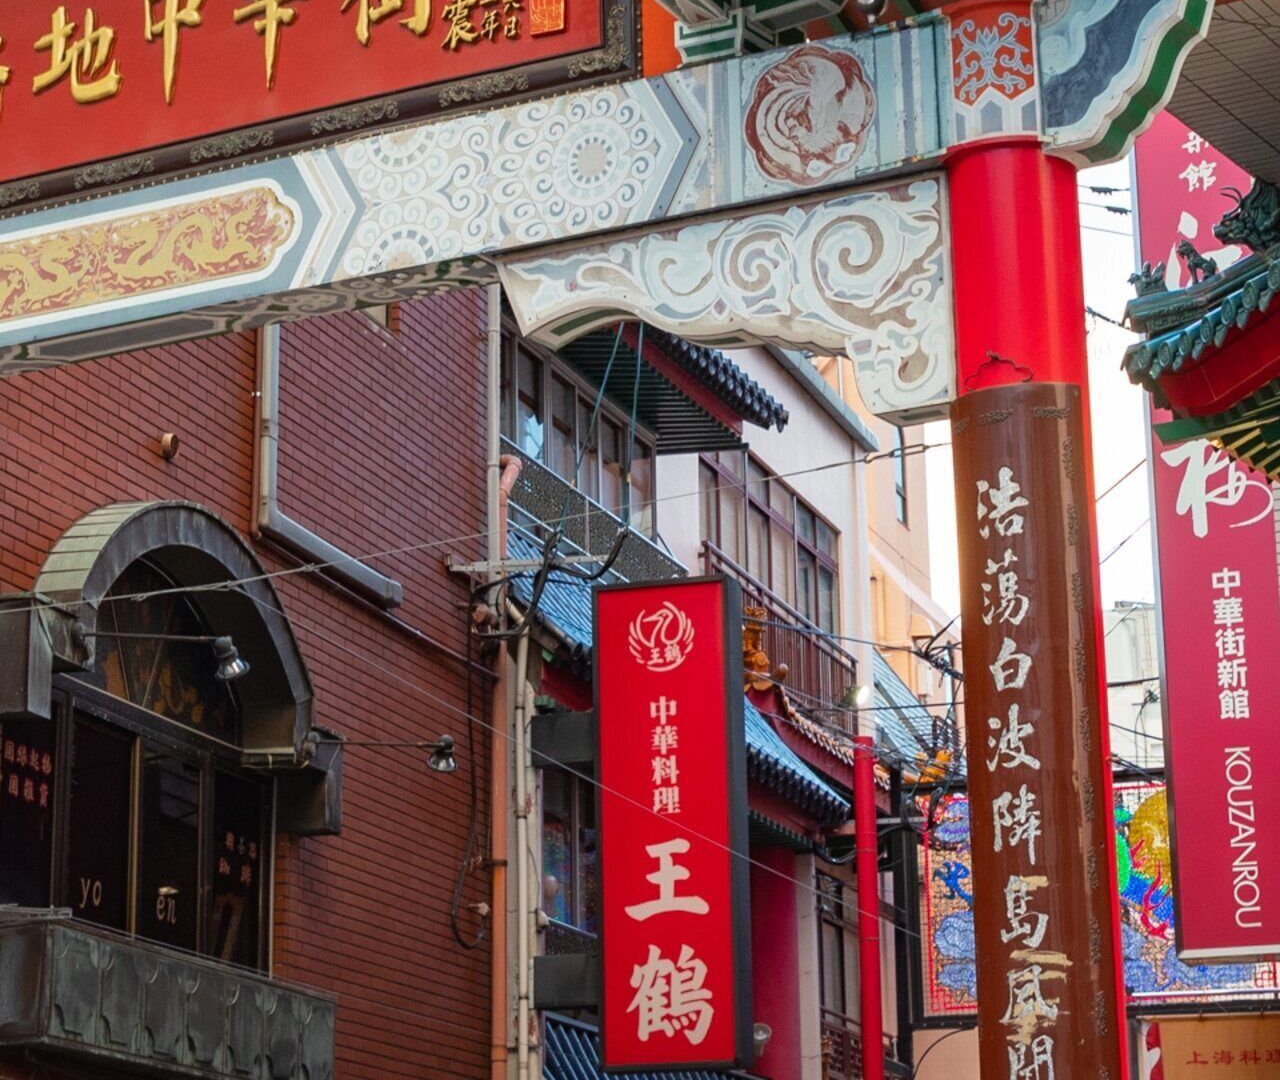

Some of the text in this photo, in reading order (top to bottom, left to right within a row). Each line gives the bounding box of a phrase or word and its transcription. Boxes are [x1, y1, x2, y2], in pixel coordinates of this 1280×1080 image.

[647, 643, 682, 665] 王鶴
[1211, 568, 1250, 719] 中華街新館
[649, 696, 681, 814] 中華料理
[1225, 746, 1262, 928] KOUZANROU
[625, 838, 714, 1045] 王鶴
